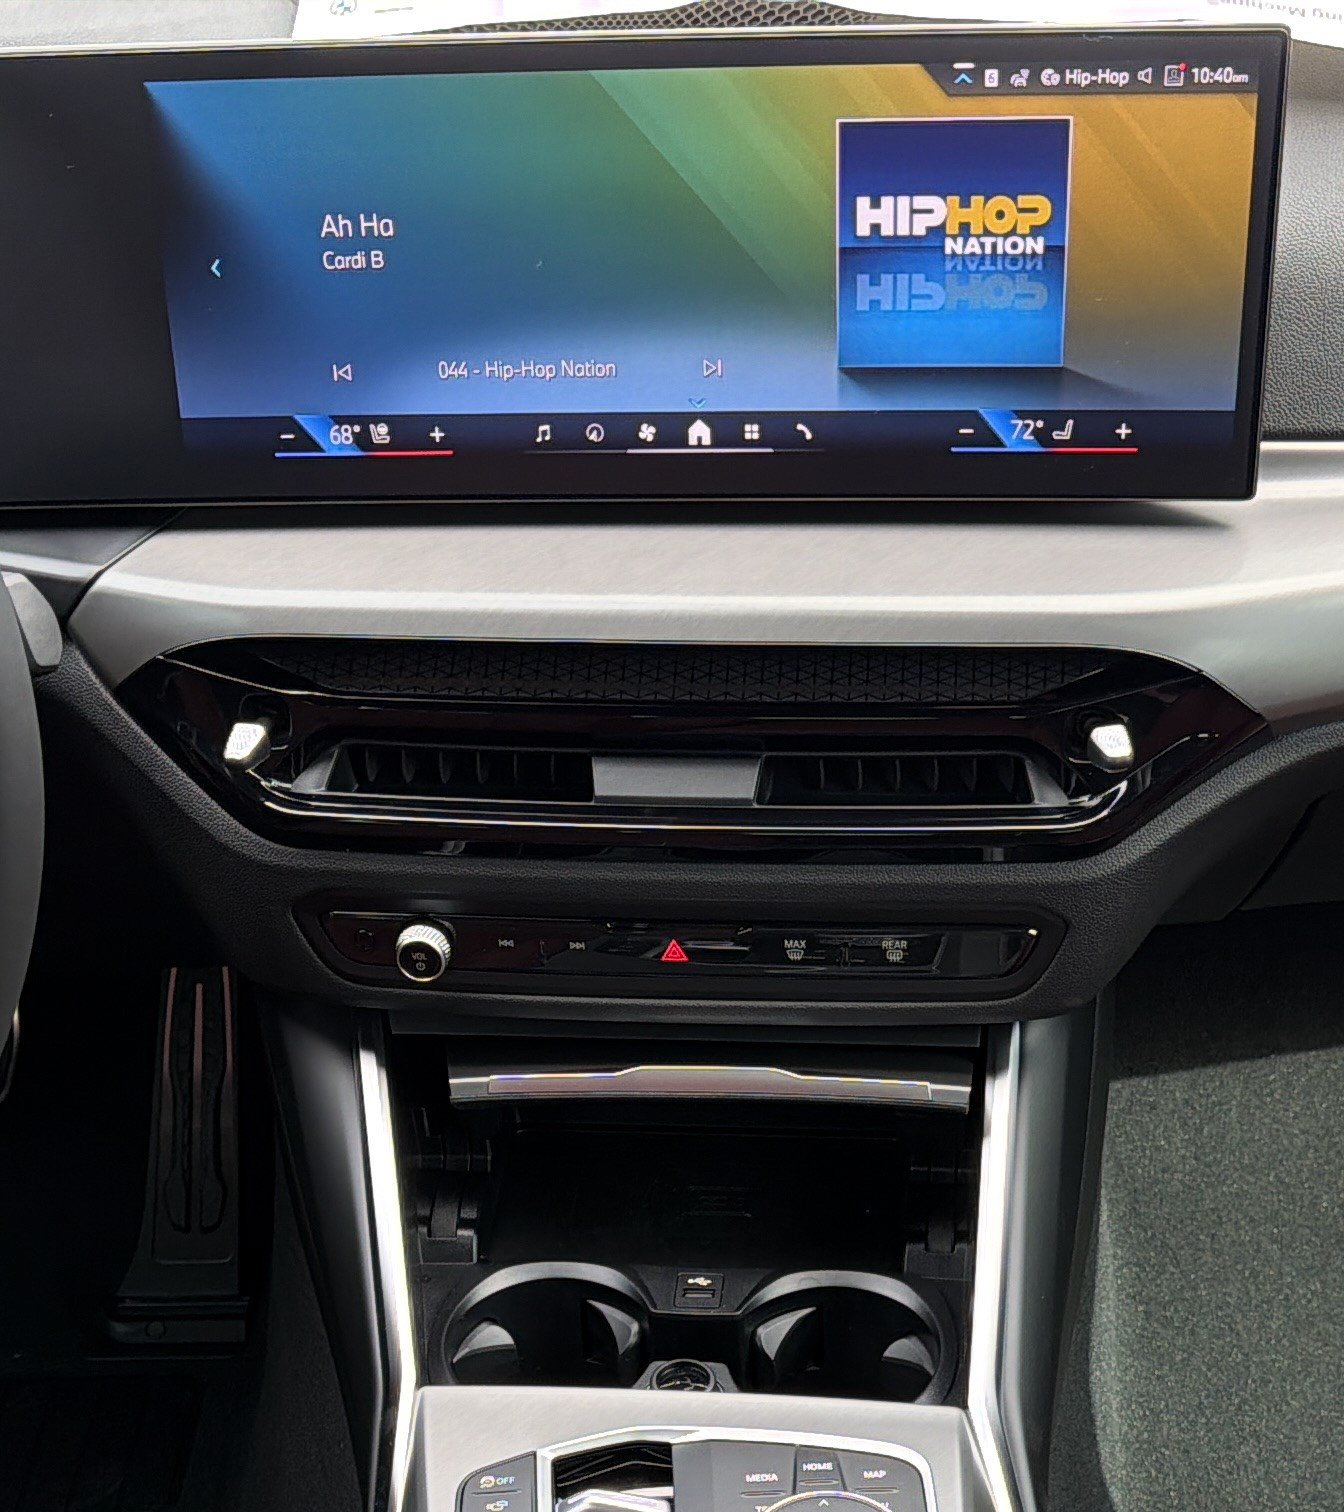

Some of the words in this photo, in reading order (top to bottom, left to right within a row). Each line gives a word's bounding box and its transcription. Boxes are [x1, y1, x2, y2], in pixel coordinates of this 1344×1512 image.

[1065, 68, 1129, 87] Hip-Hop
[320, 213, 352, 238] Ah
[360, 213, 394, 238] Ha
[944, 235, 1045, 255] NATION
[322, 250, 367, 270] Cardi
[371, 250, 385, 269] B
[438, 360, 469, 379] 044
[485, 361, 556, 382] Hip-Hop
[560, 360, 617, 378] Nation
[329, 424, 361, 445] 68°
[1011, 420, 1044, 440] 72°
[784, 939, 806, 949] MAX
[881, 940, 908, 950] REAR
[411, 952, 428, 961] VOL
[802, 1462, 833, 1471] HOME
[496, 1476, 516, 1486] OFF
[745, 1473, 779, 1483] MEDIA
[863, 1470, 887, 1480] MAP
